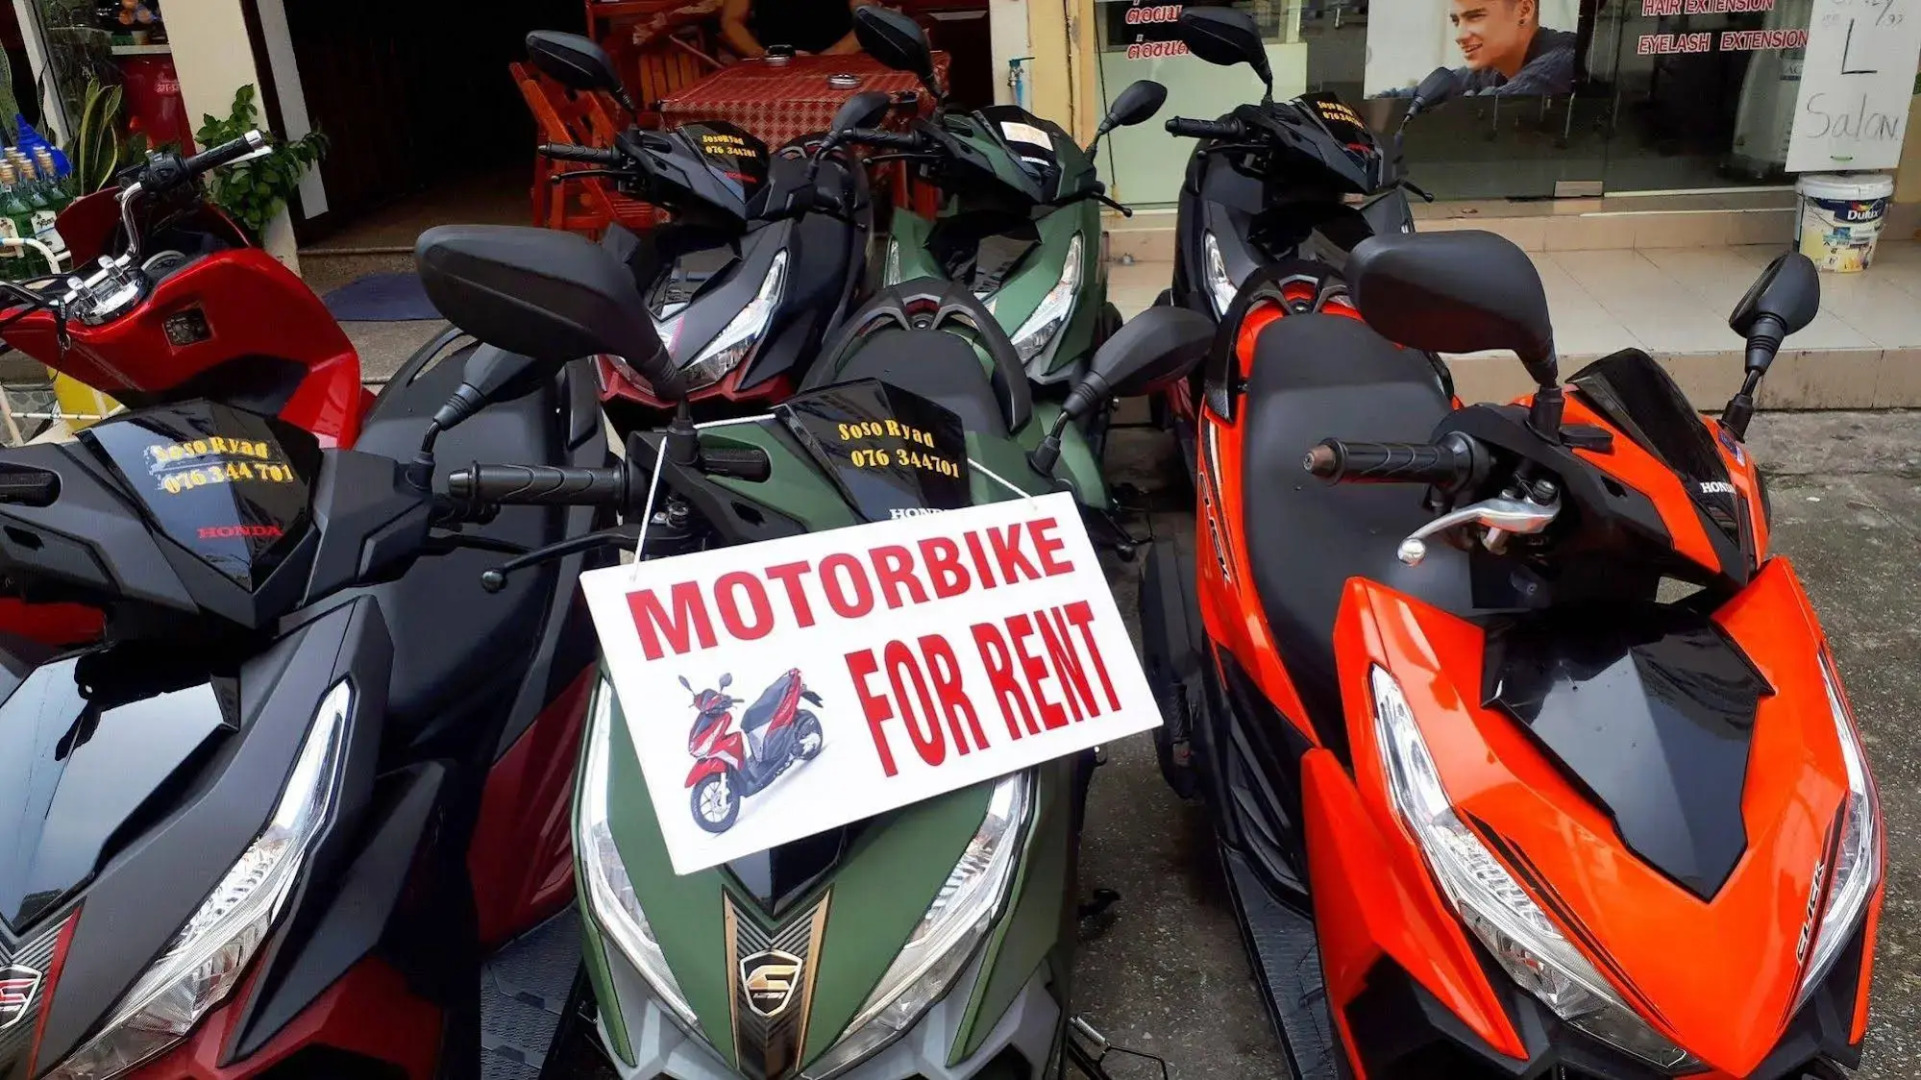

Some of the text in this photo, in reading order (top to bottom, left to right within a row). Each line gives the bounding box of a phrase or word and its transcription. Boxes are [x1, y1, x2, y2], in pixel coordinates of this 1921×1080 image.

[1642, 0, 1774, 16] HAIR EXTENSION
[1637, 29, 1808, 54] EYELASH EXTENSION
[1841, 18, 1877, 75] L
[1847, 209, 1880, 221] Dulux
[838, 419, 935, 449] Soso Ryad
[851, 448, 960, 479] 076 344701
[164, 468, 207, 494] 076
[198, 525, 283, 539] HONDA
[625, 517, 1075, 661] MOTORBIKE
[844, 600, 1122, 778] FOR RENT
